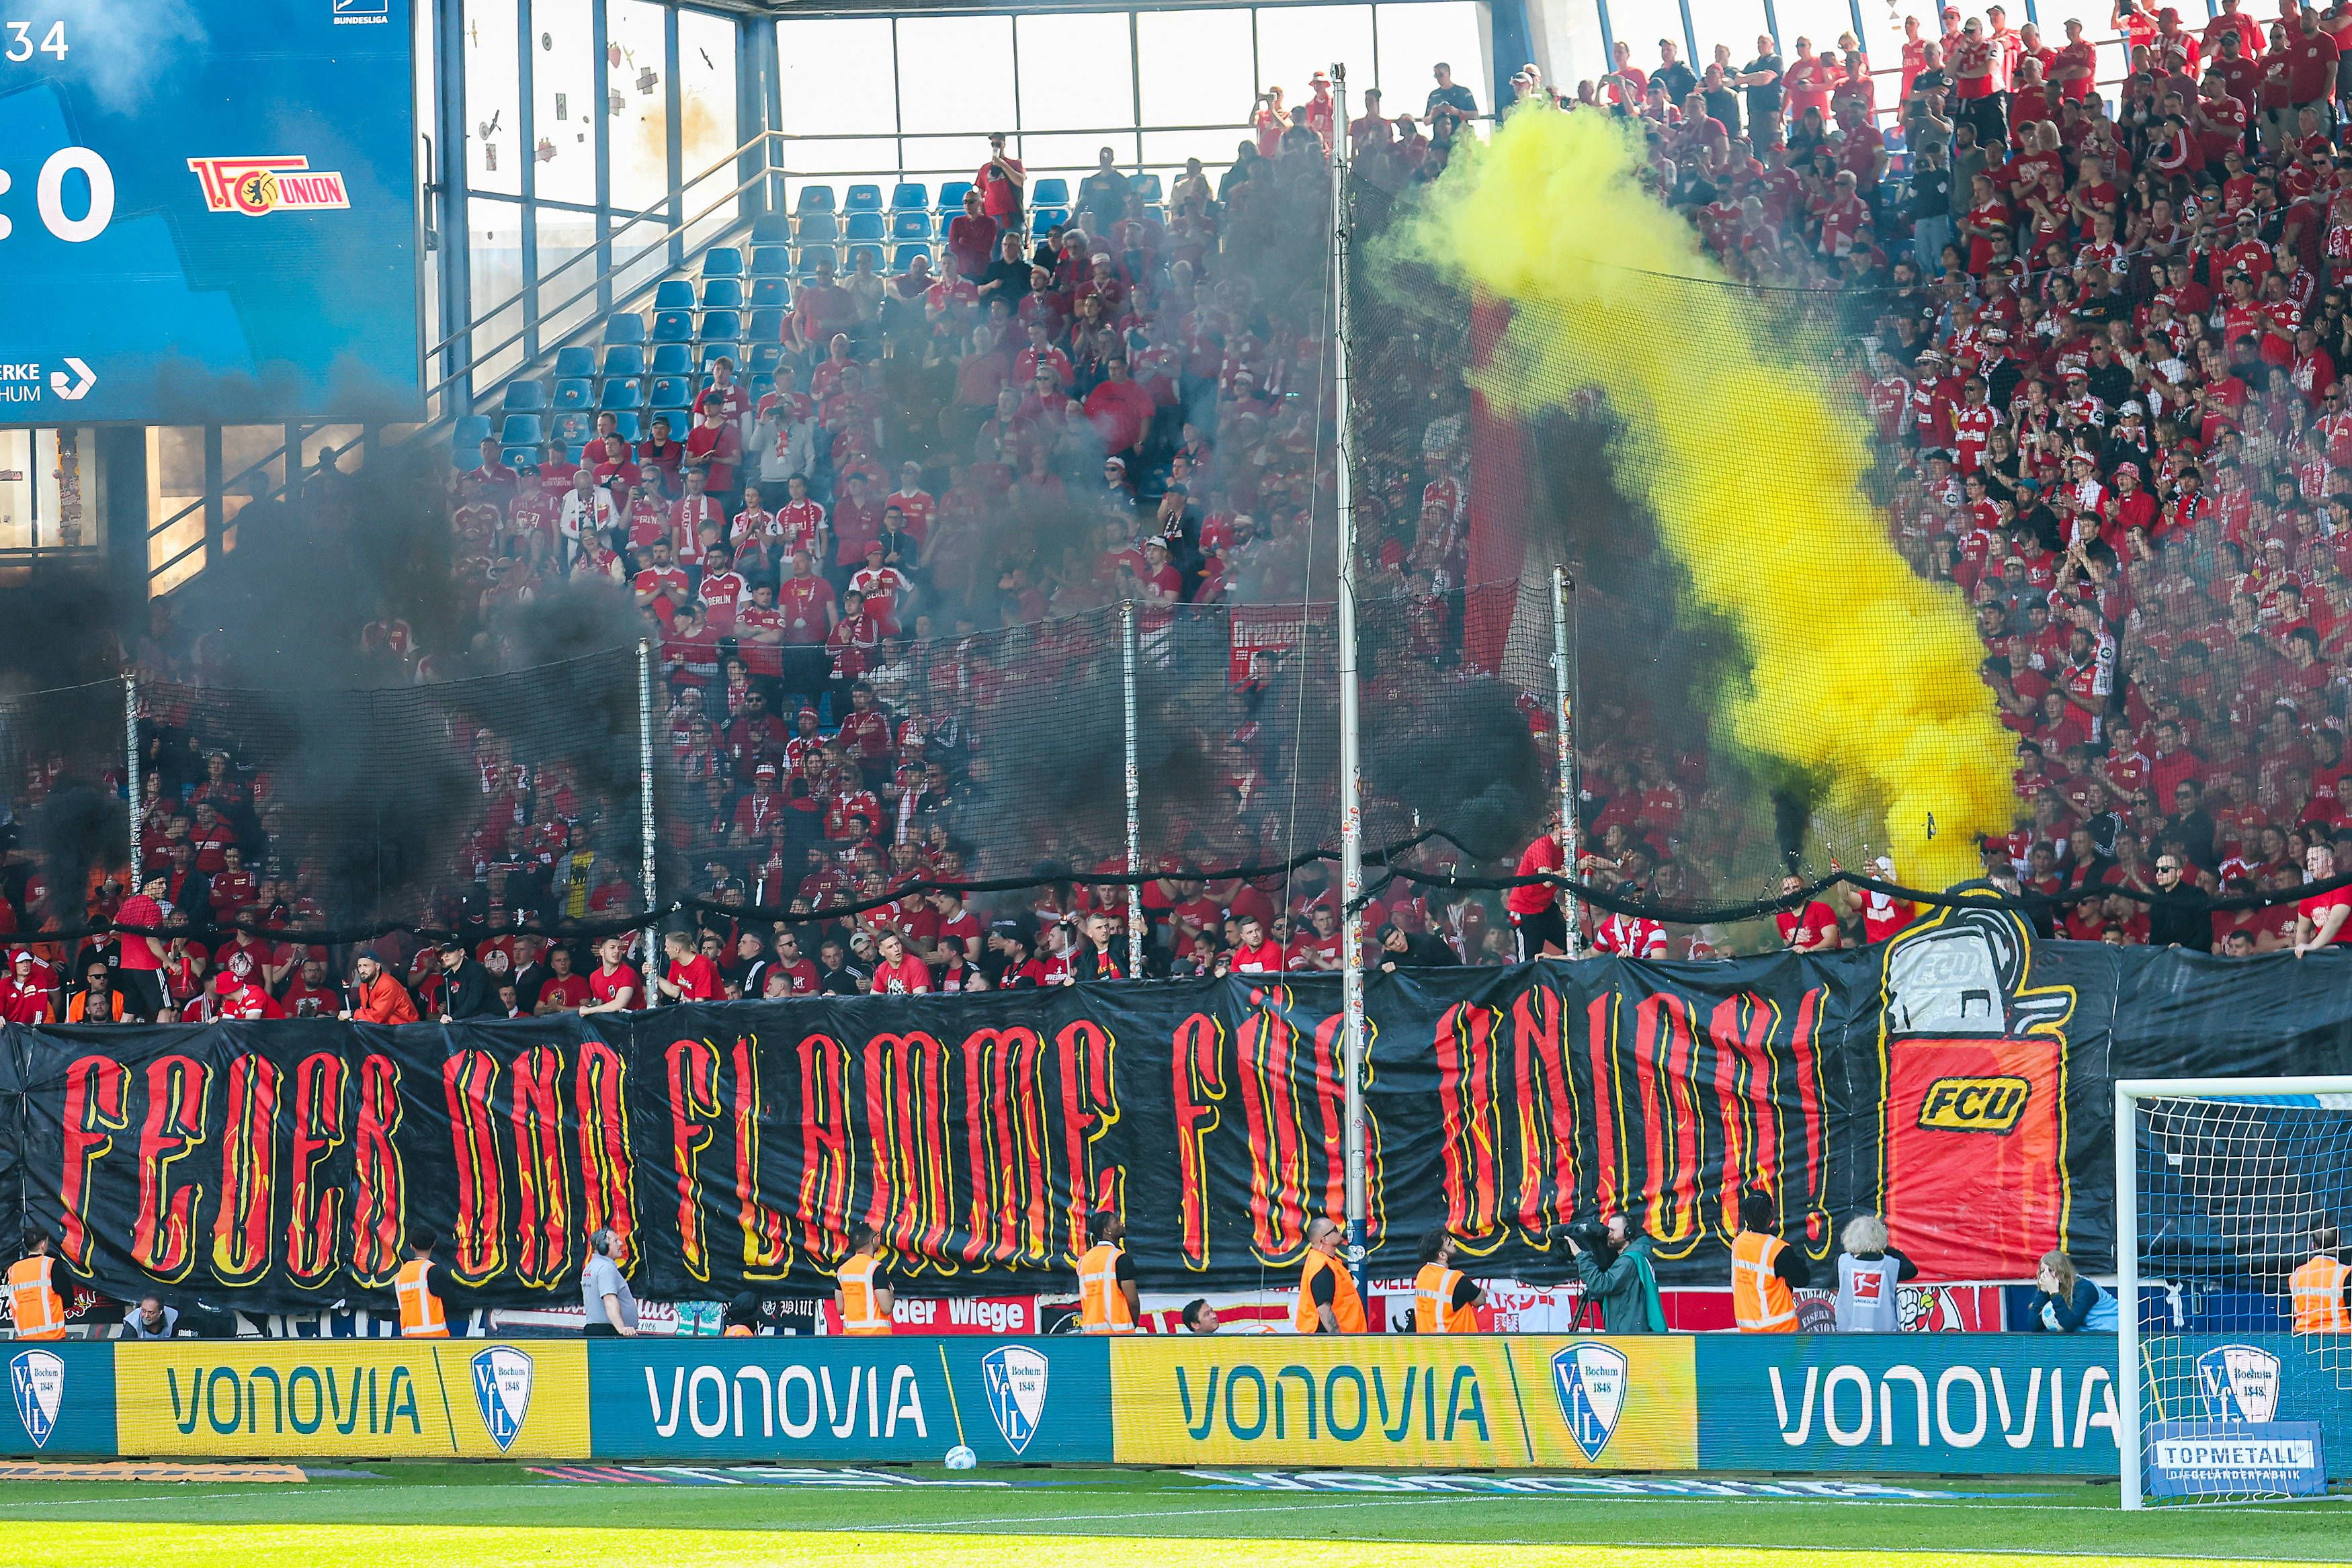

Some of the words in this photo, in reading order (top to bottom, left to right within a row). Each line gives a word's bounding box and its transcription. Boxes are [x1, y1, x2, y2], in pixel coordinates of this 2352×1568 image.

[333, 16, 388, 25] BUNDESLIGA
[5, 20, 69, 62] 34
[279, 177, 343, 204] UNION
[0, 363, 40, 381] RKE
[708, 594, 732, 606] BERLIN
[1926, 1085, 2022, 1120] FCU
[59, 1051, 405, 1290] FEUER
[443, 1041, 639, 1291] UND
[665, 1019, 1126, 1282] FLAMME
[1172, 984, 1387, 1272] FÜR
[1433, 982, 1833, 1261] UNION!
[892, 1298, 937, 1324] der
[948, 1297, 1025, 1333] Wiege
[34, 1367, 58, 1377] Bochum
[498, 1366, 526, 1377] Bochum
[1011, 1366, 1042, 1377] Bochum
[1585, 1365, 1619, 1377] Bochum
[2234, 1367, 2272, 1380] Bochum
[40, 1381, 54, 1391] 1848
[505, 1381, 520, 1391] 1848
[1019, 1381, 1036, 1392] 1848
[1593, 1383, 1611, 1393] 1848
[2244, 1385, 2264, 1397] 1848
